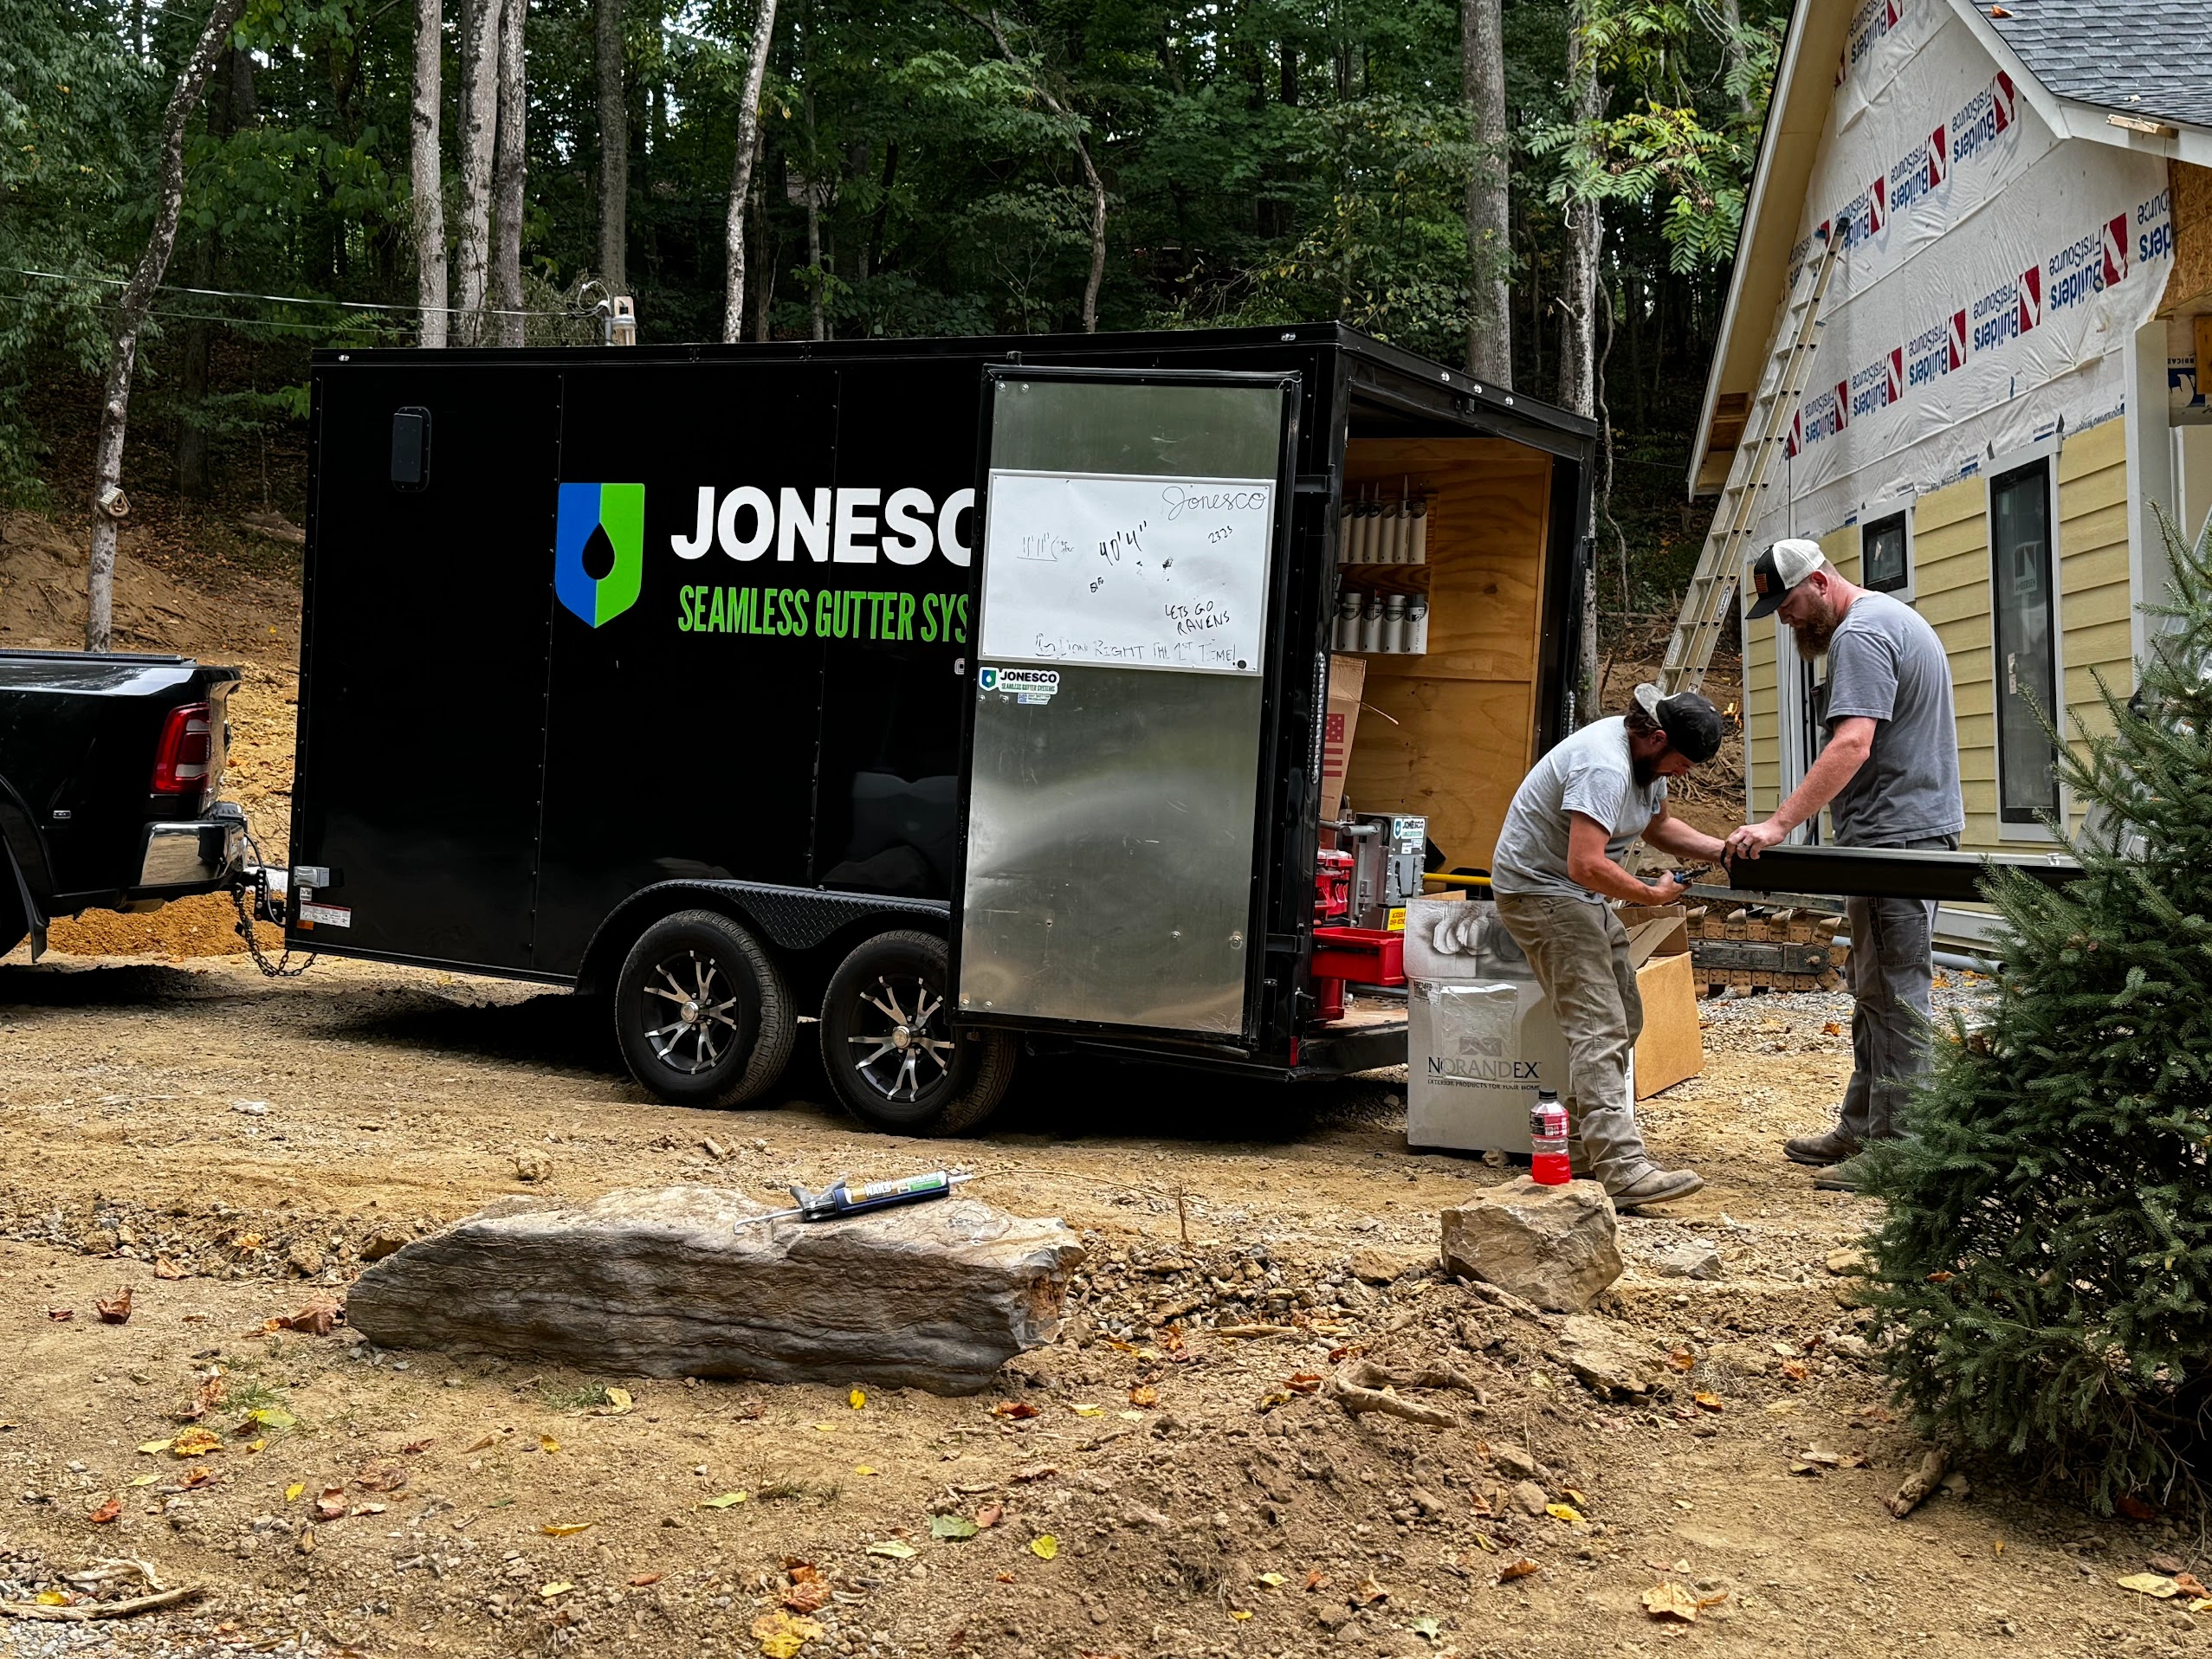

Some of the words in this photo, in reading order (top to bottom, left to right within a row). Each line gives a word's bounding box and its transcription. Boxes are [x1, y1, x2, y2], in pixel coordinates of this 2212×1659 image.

[1851, 8, 1887, 64] Builders
[1952, 83, 1992, 133] FirstSource
[1953, 108, 1995, 164] Builders
[1891, 140, 1927, 184] FirstSource
[1891, 165, 1929, 213] Builders
[2049, 229, 2102, 276] FirstSource
[1974, 279, 2018, 320] FirstSource
[2051, 259, 2105, 310] Builders
[1909, 320, 1948, 358] FirstSource
[1974, 306, 2019, 352] Builders
[1852, 357, 1886, 390] FirstSource
[1909, 345, 1948, 386] Builders
[1804, 388, 1834, 418] FirstSource
[1853, 380, 1887, 417] Builders
[1805, 410, 1835, 444] Builders
[670, 486, 976, 567] JONESC
[677, 584, 810, 637] SEAMLESS
[815, 590, 915, 642] GUTTER
[921, 592, 969, 643] SYS
[1165, 604, 1188, 620] LETS
[1194, 600, 1213, 616] GO
[1177, 610, 1230, 636] RAVENS
[999, 671, 1057, 683] JONESCO
[1427, 1055, 1540, 1079] NORANDEX
